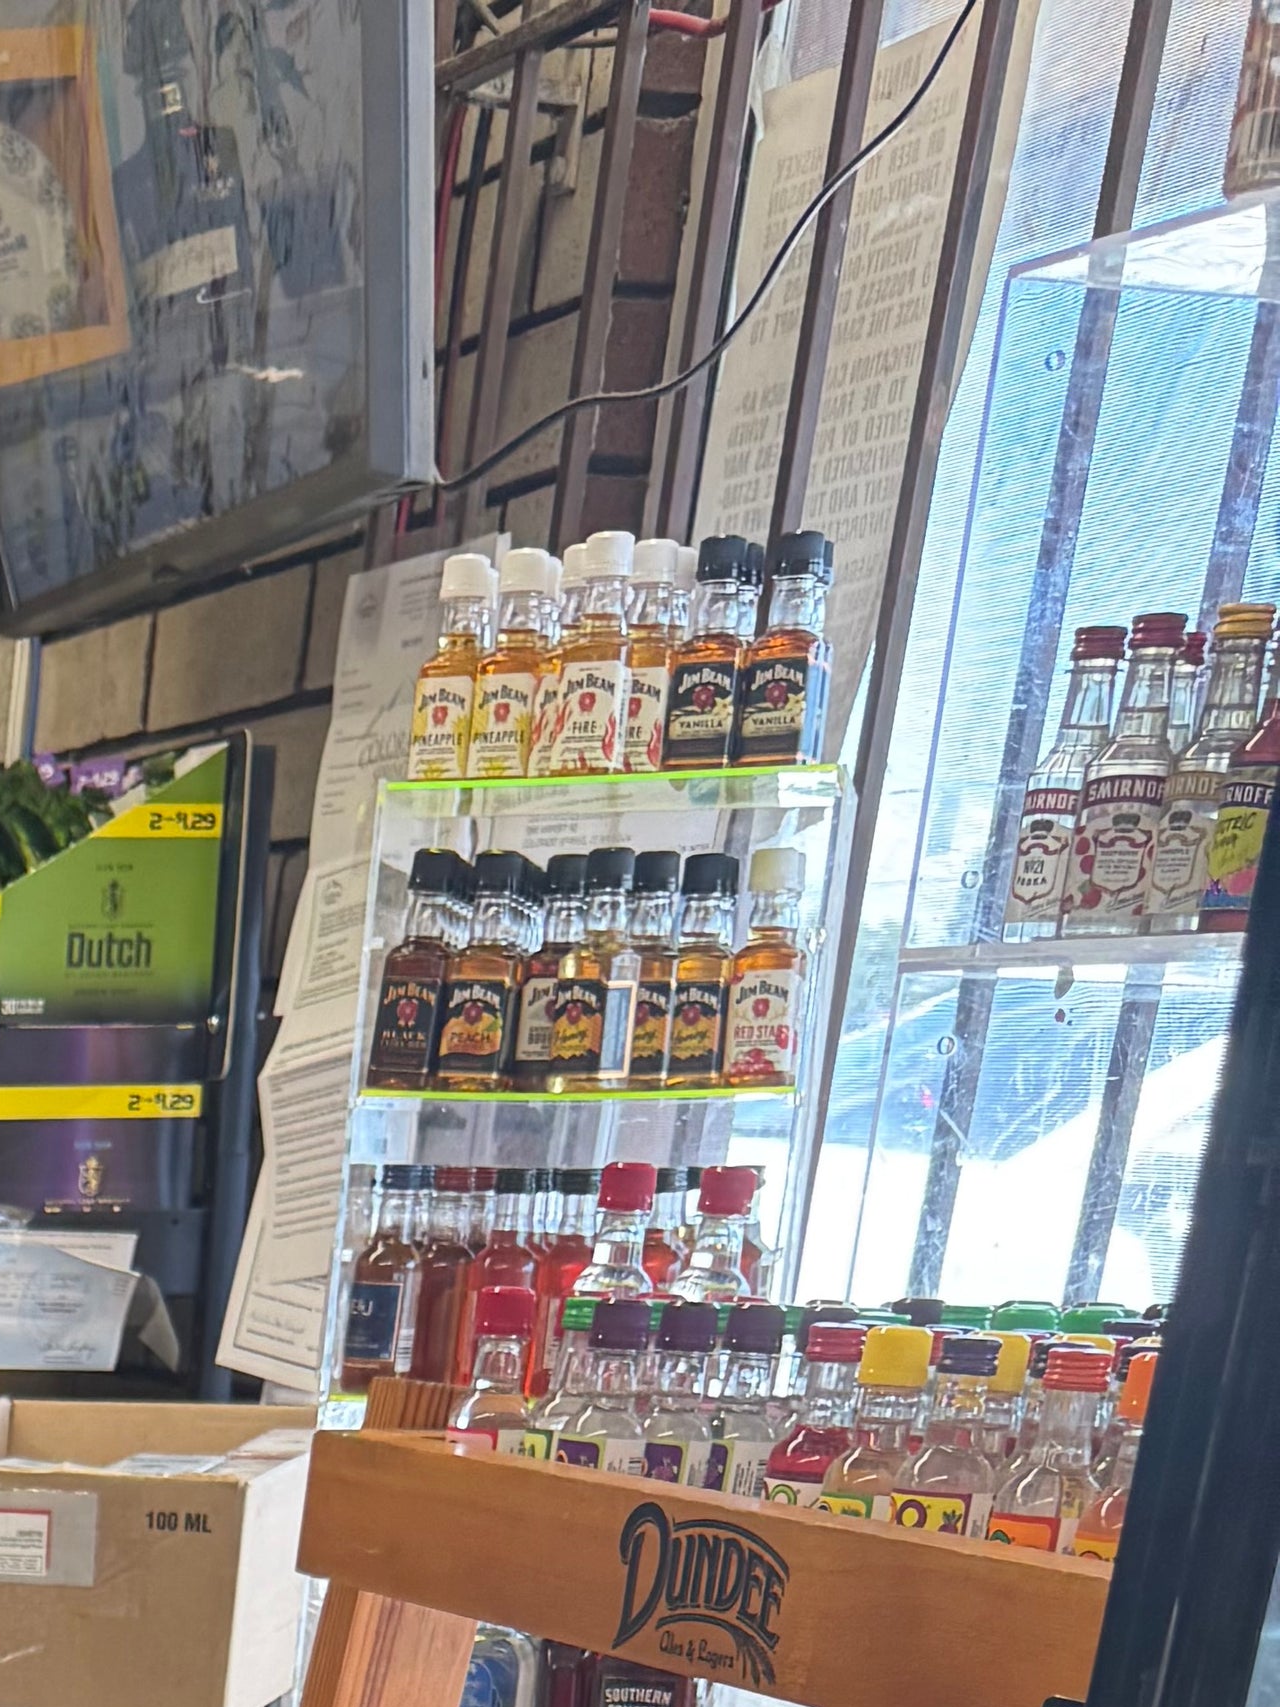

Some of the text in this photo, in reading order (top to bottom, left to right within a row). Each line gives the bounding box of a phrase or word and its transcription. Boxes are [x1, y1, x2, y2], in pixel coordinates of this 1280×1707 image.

[562, 675, 616, 697] JIM BEAM
[677, 666, 733, 693] JIM BEAM
[750, 663, 804, 690] JIM BEAM
[418, 687, 466, 711] JIM BEAM
[478, 684, 529, 707] JIM BEAM
[678, 718, 724, 730] VANILLA
[751, 714, 797, 726] VANILLA
[413, 731, 463, 747] PINEAPPLE
[472, 729, 525, 745] PINEAPPLE
[65, 931, 153, 970] Dutch
[448, 983, 501, 1008] JIM BEAM
[736, 980, 789, 1004] JIM BEAM
[449, 1031, 491, 1046] PEACH
[734, 1025, 755, 1040] RED
[145, 1510, 212, 1533] 100 ML
[611, 1501, 791, 1654] DUNDEE
[604, 1682, 673, 1706] SOUTHERN
